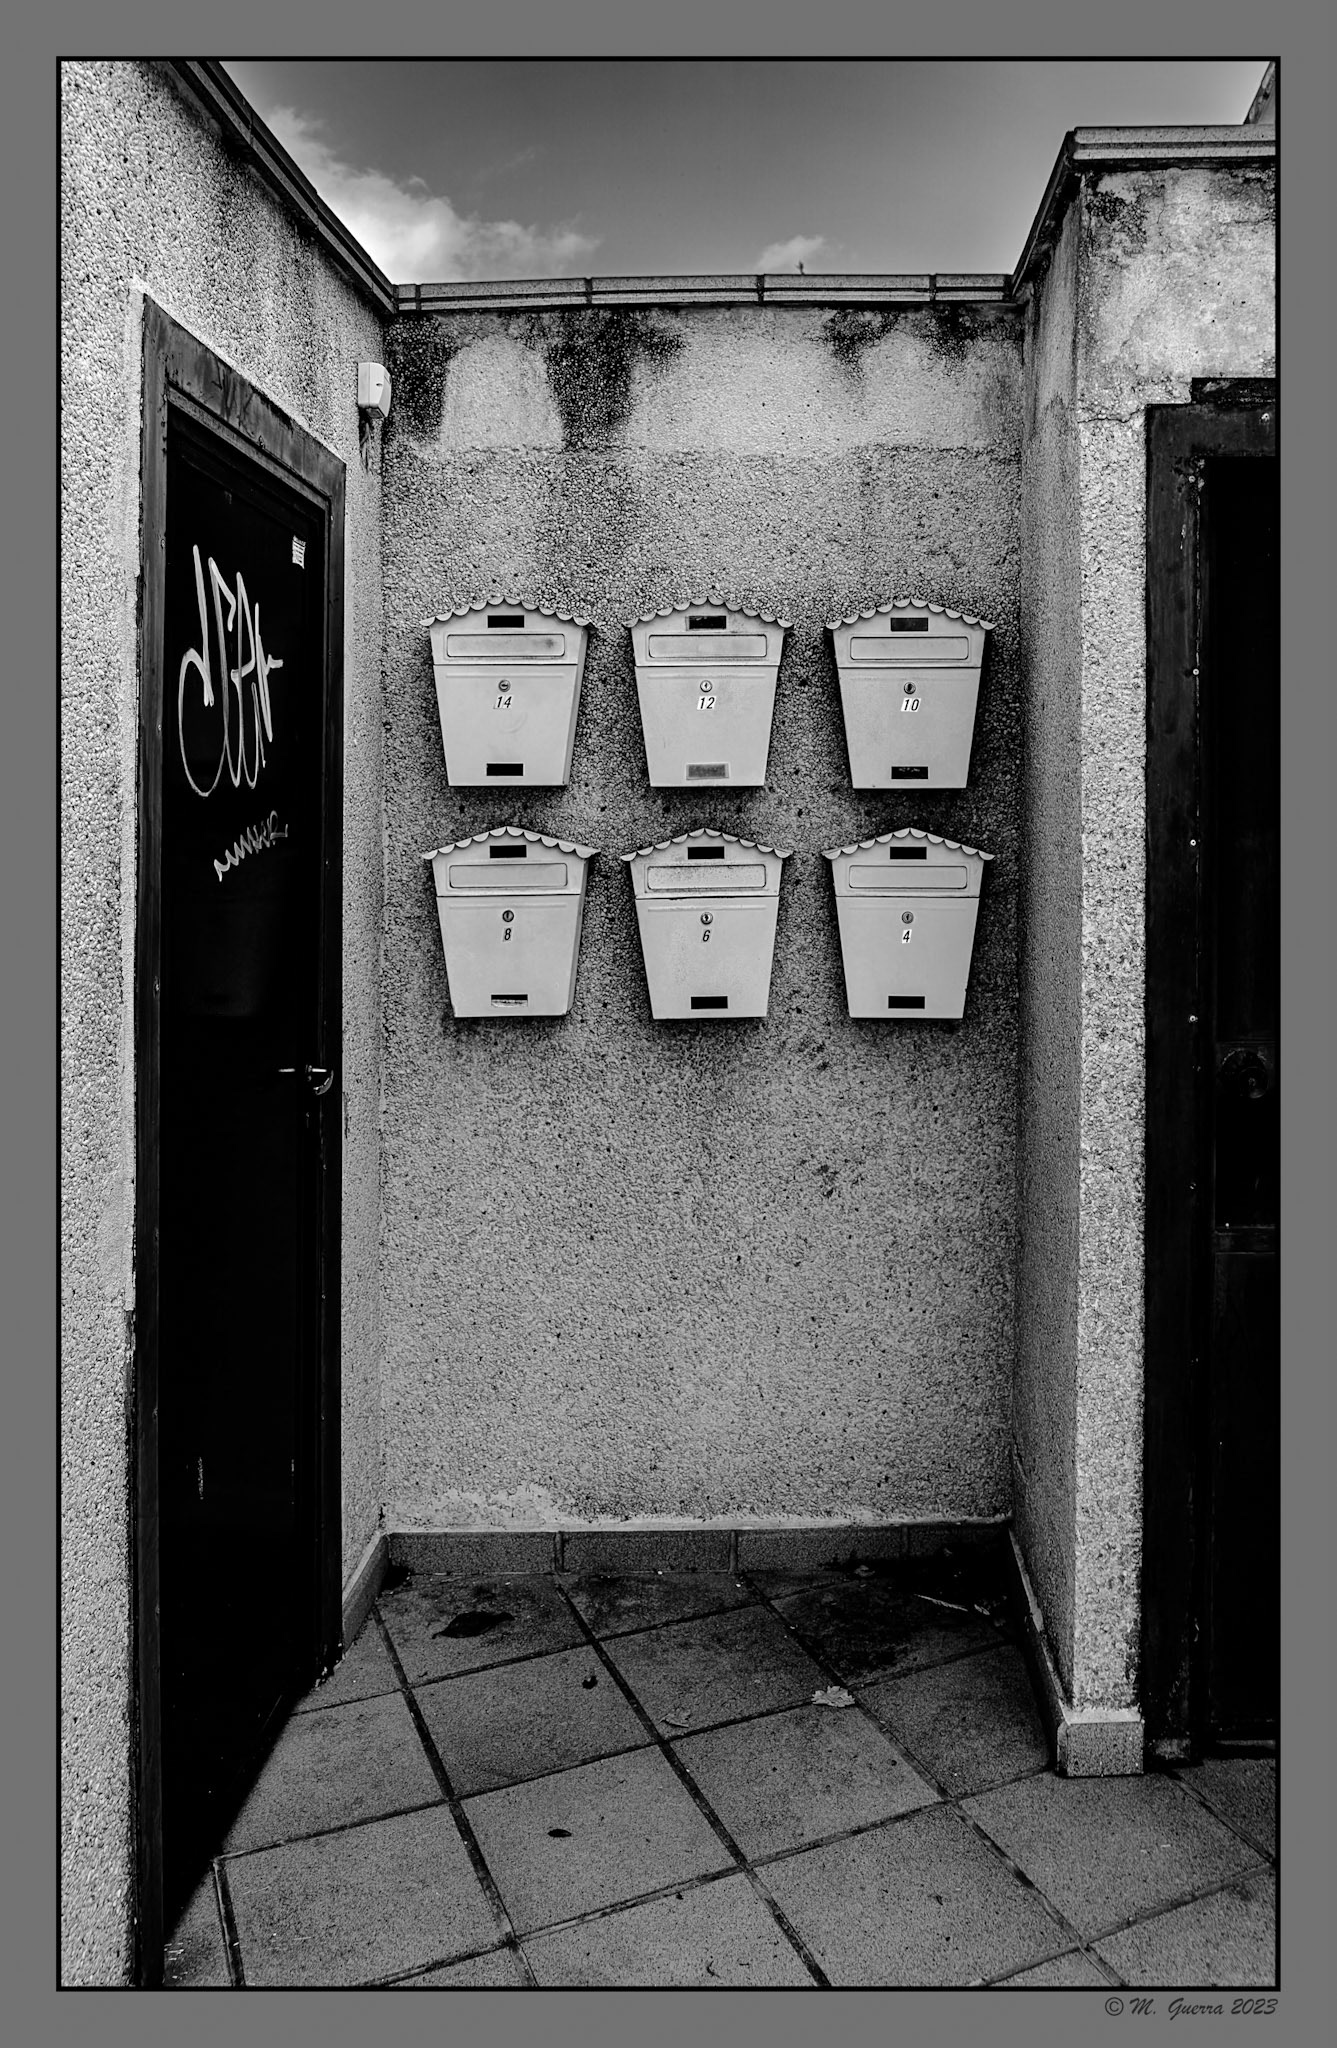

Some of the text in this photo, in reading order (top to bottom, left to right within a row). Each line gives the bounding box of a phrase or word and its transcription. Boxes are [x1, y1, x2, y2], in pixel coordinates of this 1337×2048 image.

[497, 696, 512, 709] 14
[700, 696, 715, 709] 12
[904, 698, 920, 711] 10
[504, 927, 512, 941] 8
[702, 929, 711, 942] 6
[902, 930, 910, 943] 4
